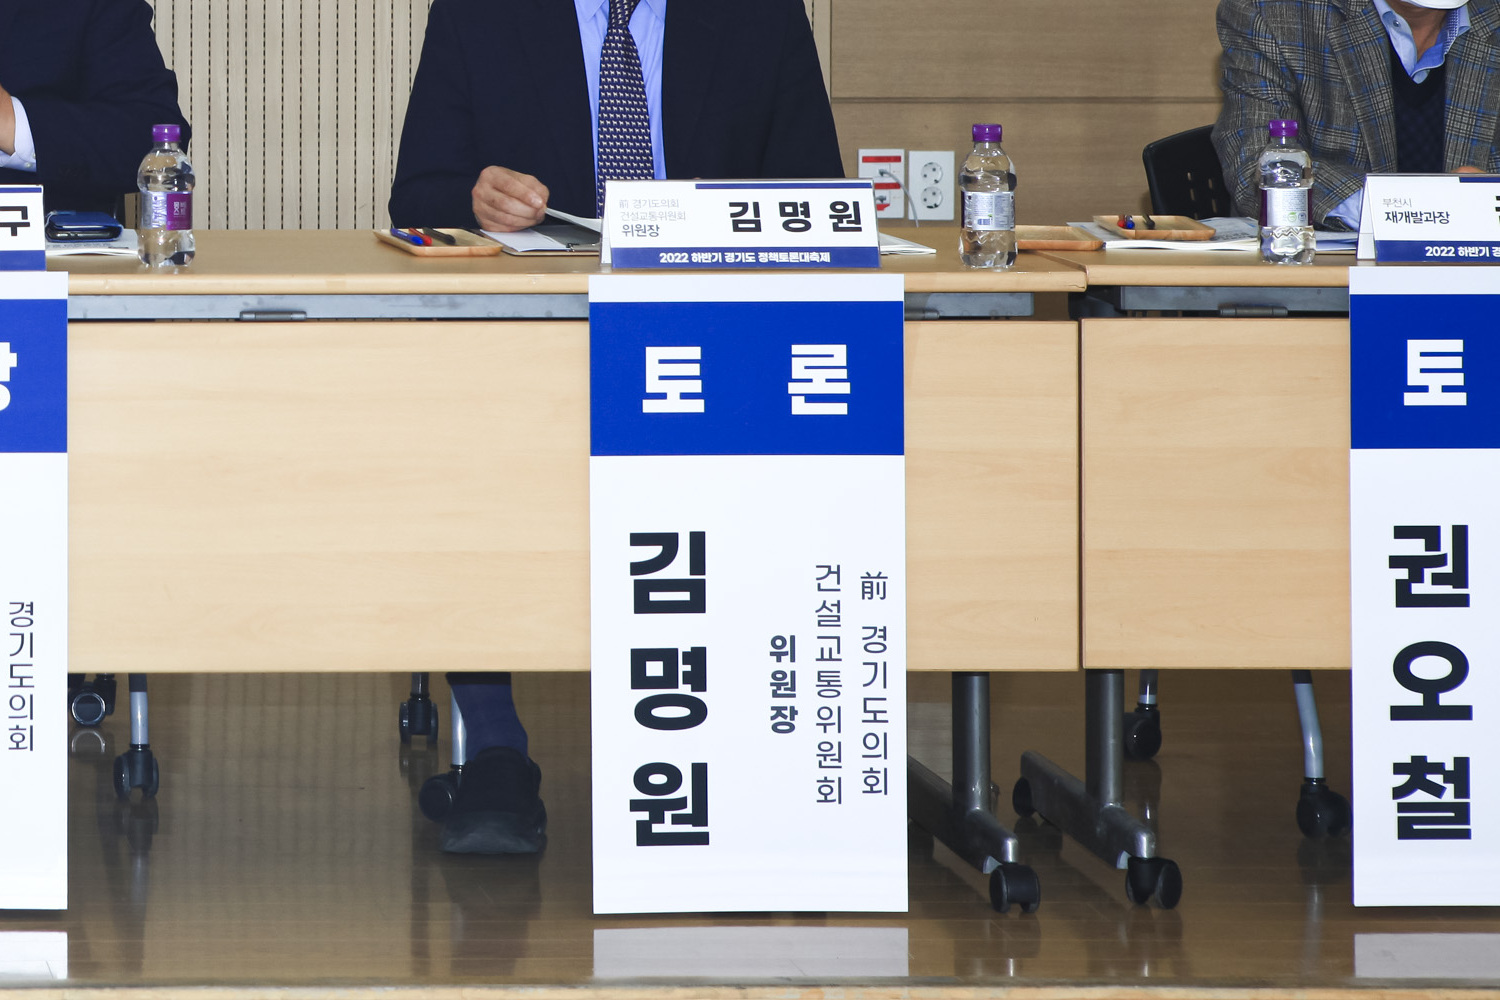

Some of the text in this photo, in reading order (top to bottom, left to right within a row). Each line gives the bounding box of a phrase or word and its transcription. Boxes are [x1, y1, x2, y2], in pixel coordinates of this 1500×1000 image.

[622, 224, 659, 237] 위원장
[1383, 198, 1412, 207] 부천시
[1385, 211, 1449, 224] 재개발과장
[1425, 246, 1455, 256] 2022
[1458, 247, 1489, 257] 하반기
[659, 252, 830, 263] 2022 하반기 경기도 정책토론대축제
[9, 602, 34, 751] 경기도의회
[630, 531, 709, 846] 김명원
[770, 635, 798, 734] 위원장
[815, 565, 842, 804] 건설교통위원회
[861, 572, 888, 795] 前 경기도의회
[1389, 525, 1472, 840] 권오철
